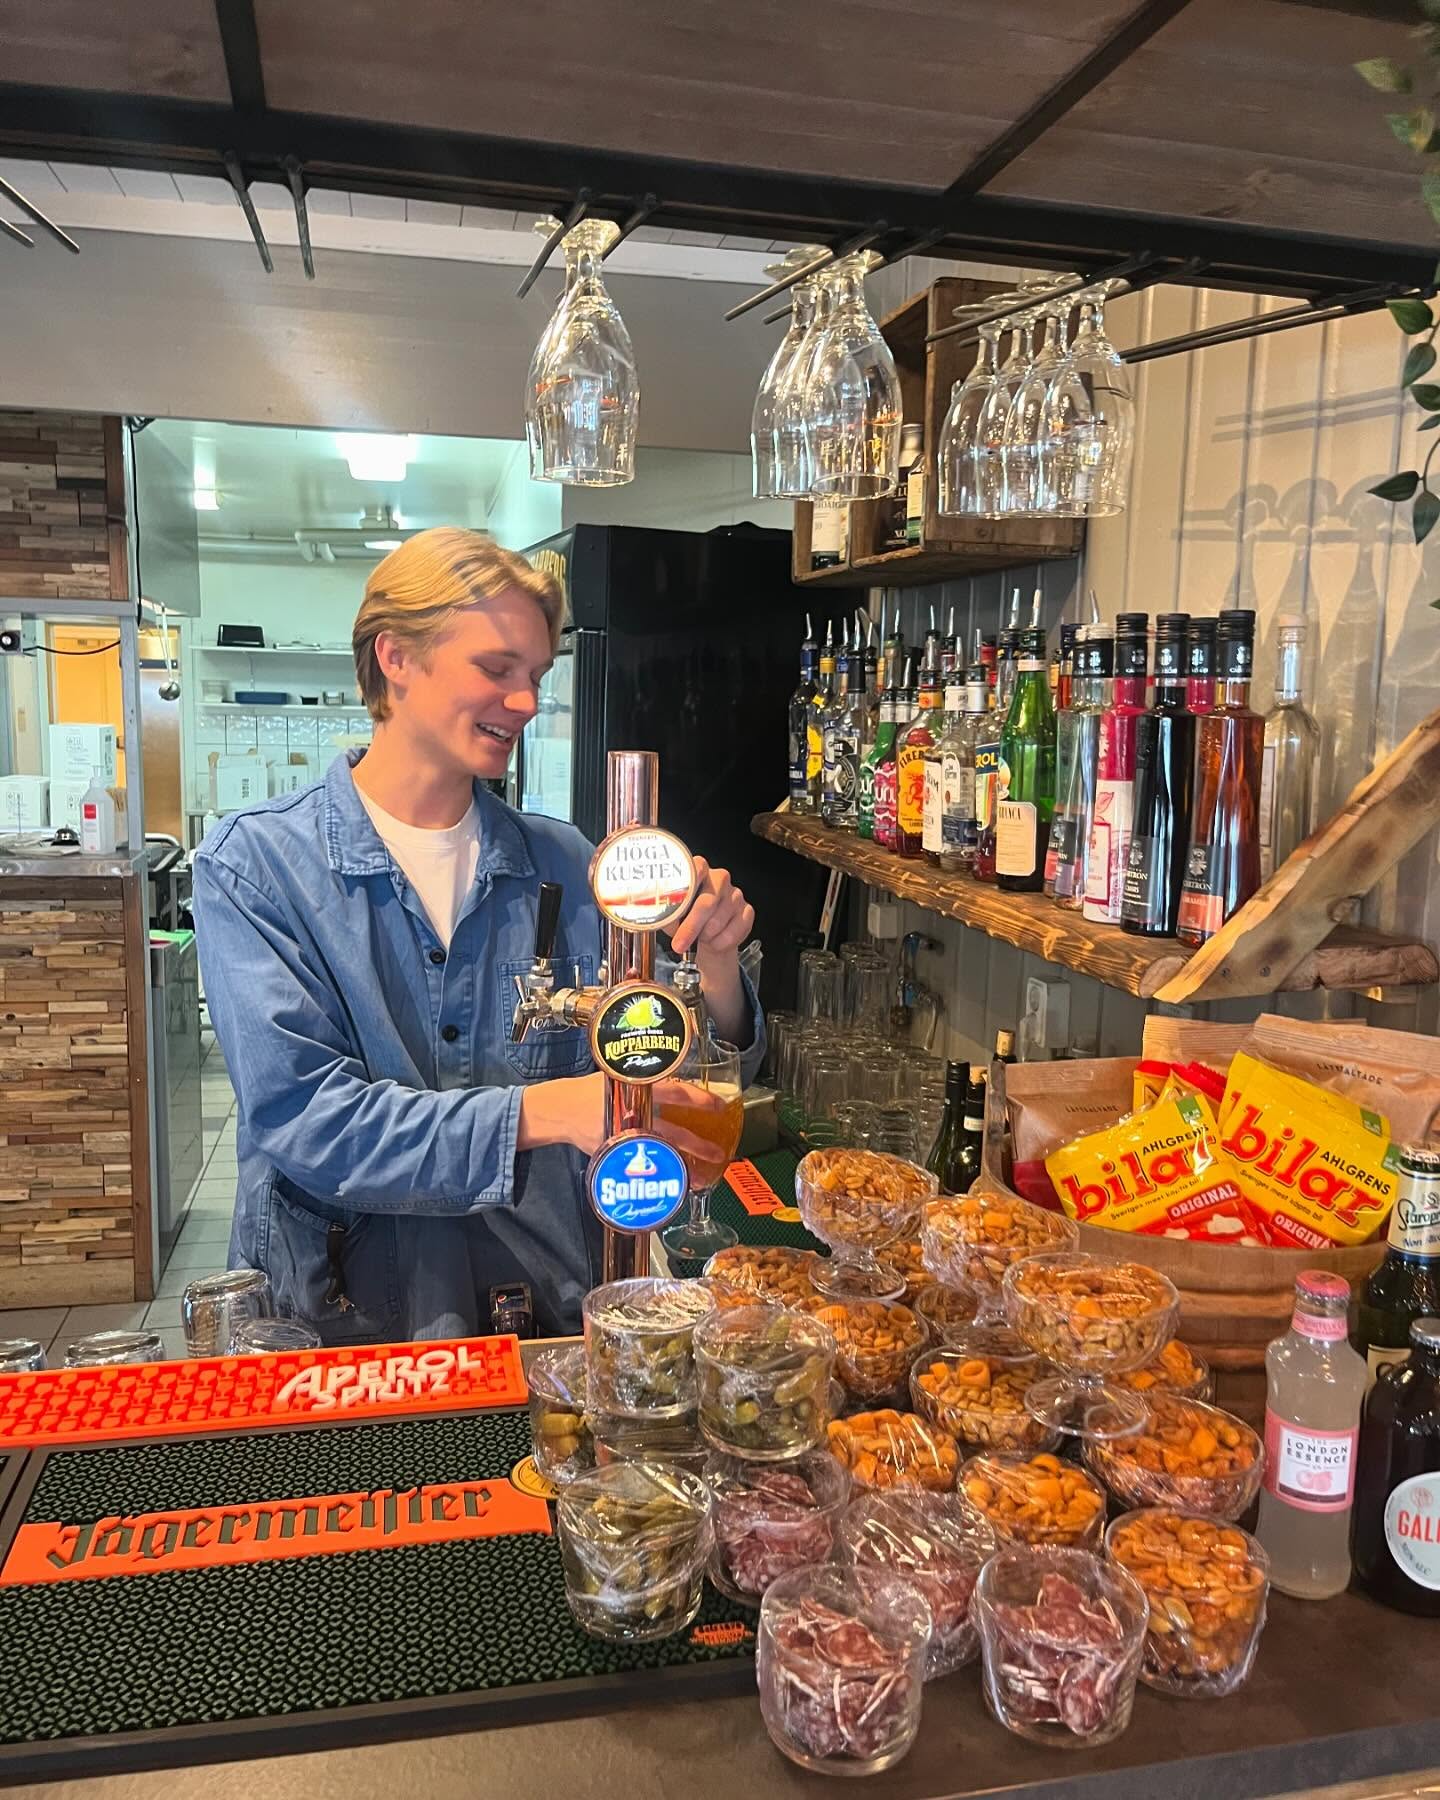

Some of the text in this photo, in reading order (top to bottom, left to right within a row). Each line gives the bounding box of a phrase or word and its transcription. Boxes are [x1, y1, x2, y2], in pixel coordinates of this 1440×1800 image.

[617, 841, 670, 861] HÖGA
[606, 862, 682, 881] KUSTEN
[605, 1035, 680, 1060] KOPPARBERG
[1142, 1124, 1209, 1156] AHLGRENS
[1061, 1135, 1219, 1221] bilar
[1221, 1104, 1384, 1228] bilar
[1239, 1169, 1270, 1190] Sveriges
[1320, 1151, 1391, 1195] AHLGRENS
[601, 1177, 679, 1205] Sofiero
[1170, 1183, 1238, 1218] ORIGINAL
[1274, 1214, 1336, 1248] ORIGINA
[276, 1345, 482, 1401] APEROL
[311, 1371, 450, 1411] SPRITZ
[1286, 1447, 1347, 1463] ESSENCE
[1287, 1438, 1348, 1454] LONDON
[46, 1486, 492, 1569] Jägermeister
